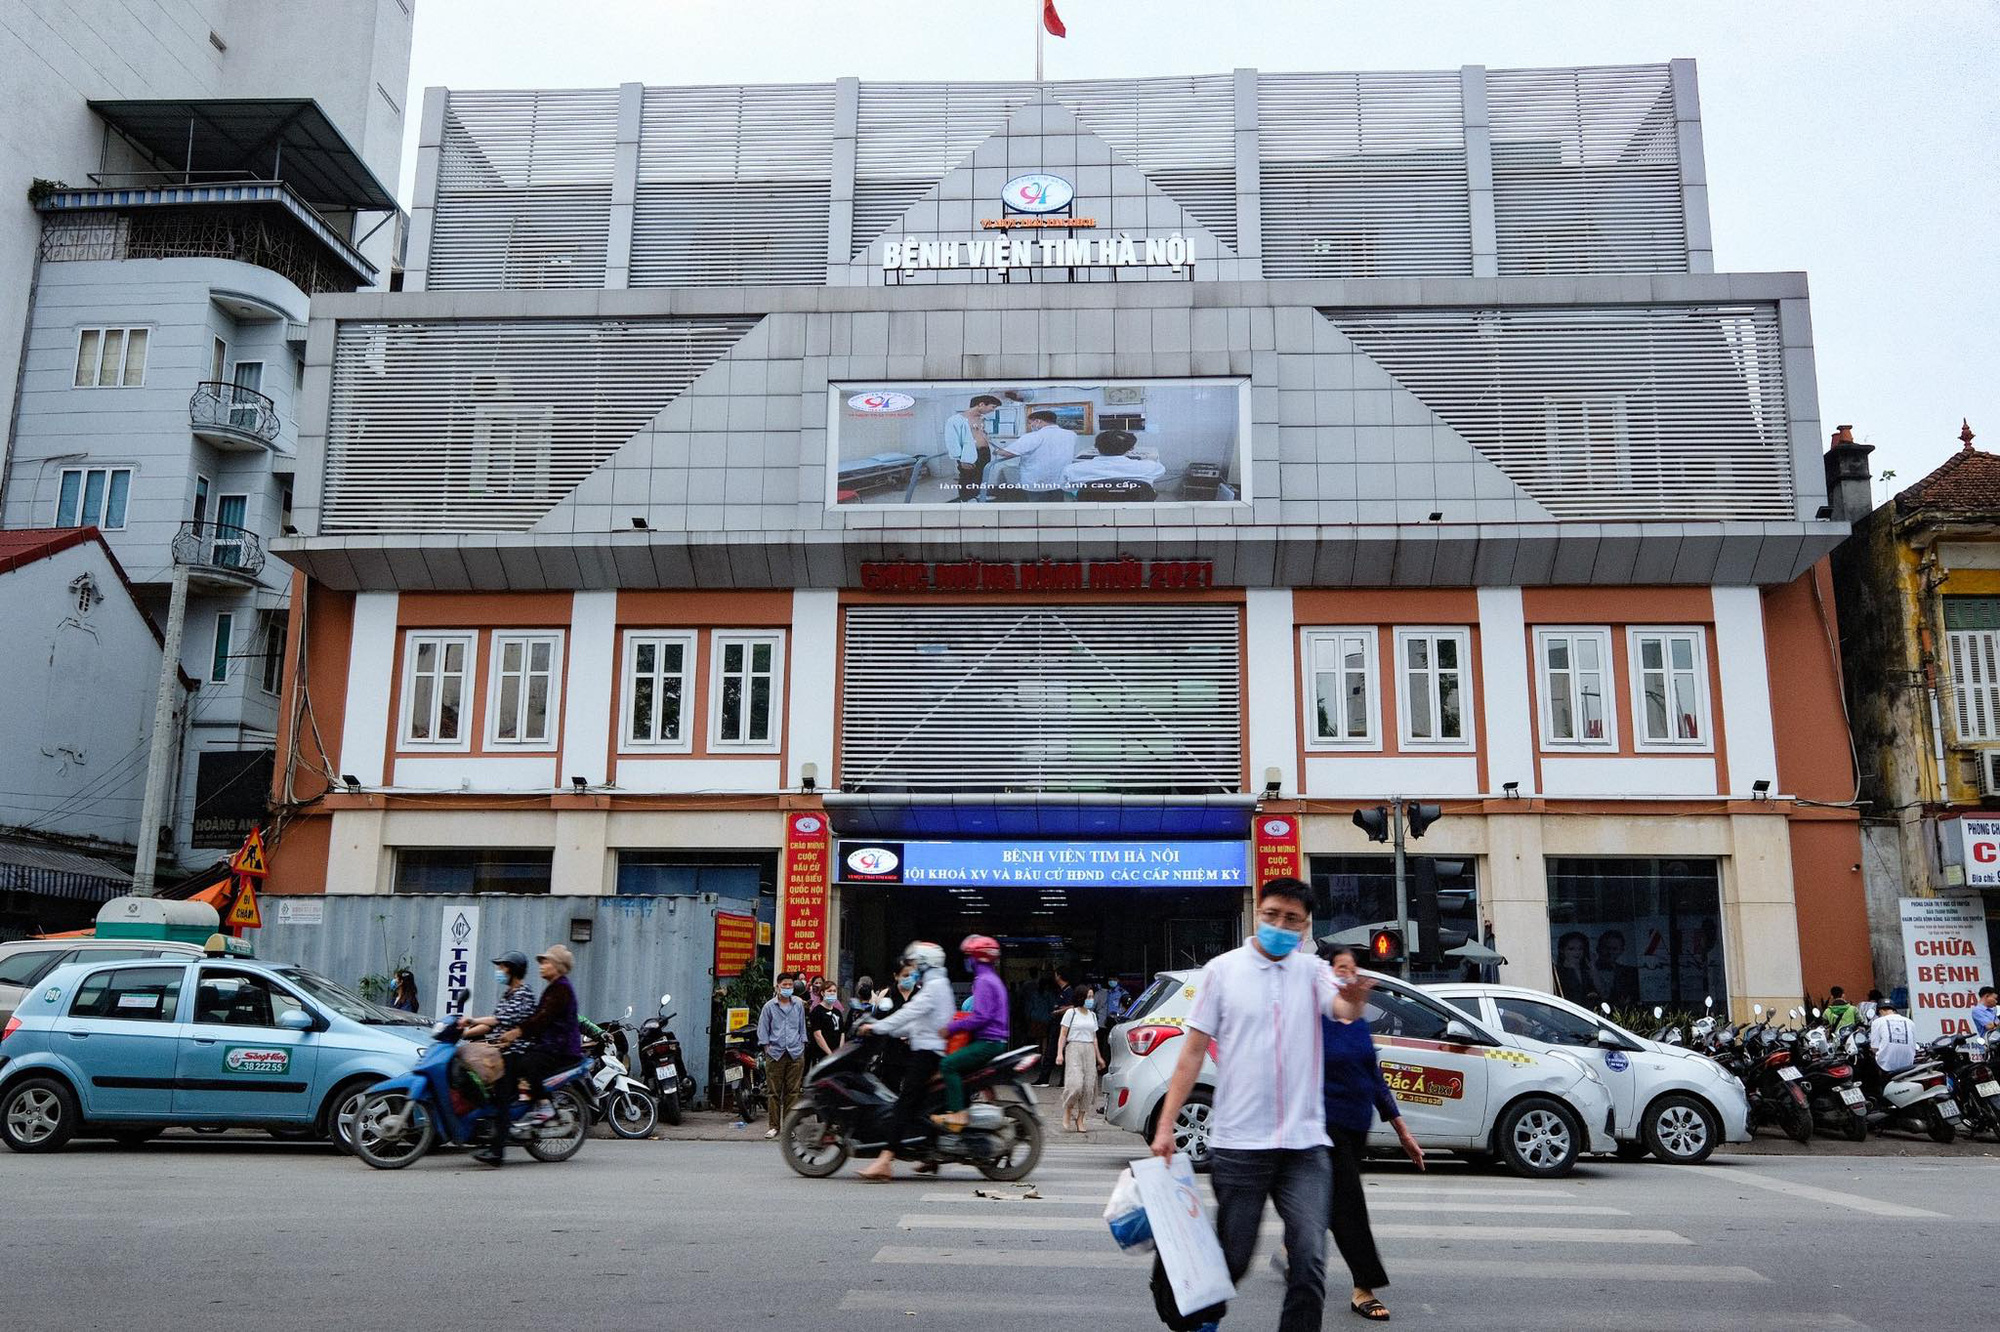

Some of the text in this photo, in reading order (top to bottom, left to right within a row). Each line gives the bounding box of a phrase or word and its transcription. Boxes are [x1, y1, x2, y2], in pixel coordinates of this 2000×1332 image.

[883, 232, 1195, 277] BỆNH VIỆN TIM HÀ NỘI
[1002, 848, 1180, 866] BỆNH VIỆN TIM HÀ NỘI
[928, 867, 967, 880] KHOÁ
[971, 869, 988, 880] XV
[992, 867, 1010, 880] VÀ
[1015, 866, 1041, 880] BẦU
[1044, 866, 1065, 880] CỬ
[1067, 869, 1105, 881] HĐND
[1111, 867, 1140, 880] CÁC
[1143, 866, 1169, 880] CẤP
[1173, 867, 1218, 882] NHIỆM
[1221, 867, 1241, 880] KỲ
[811, 897, 822, 905] XV
[1914, 937, 1976, 956] CHỮA
[1917, 963, 1980, 984] BỆNH
[1917, 990, 1980, 1009] NGOÀ
[1940, 1018, 1972, 1035] DA
